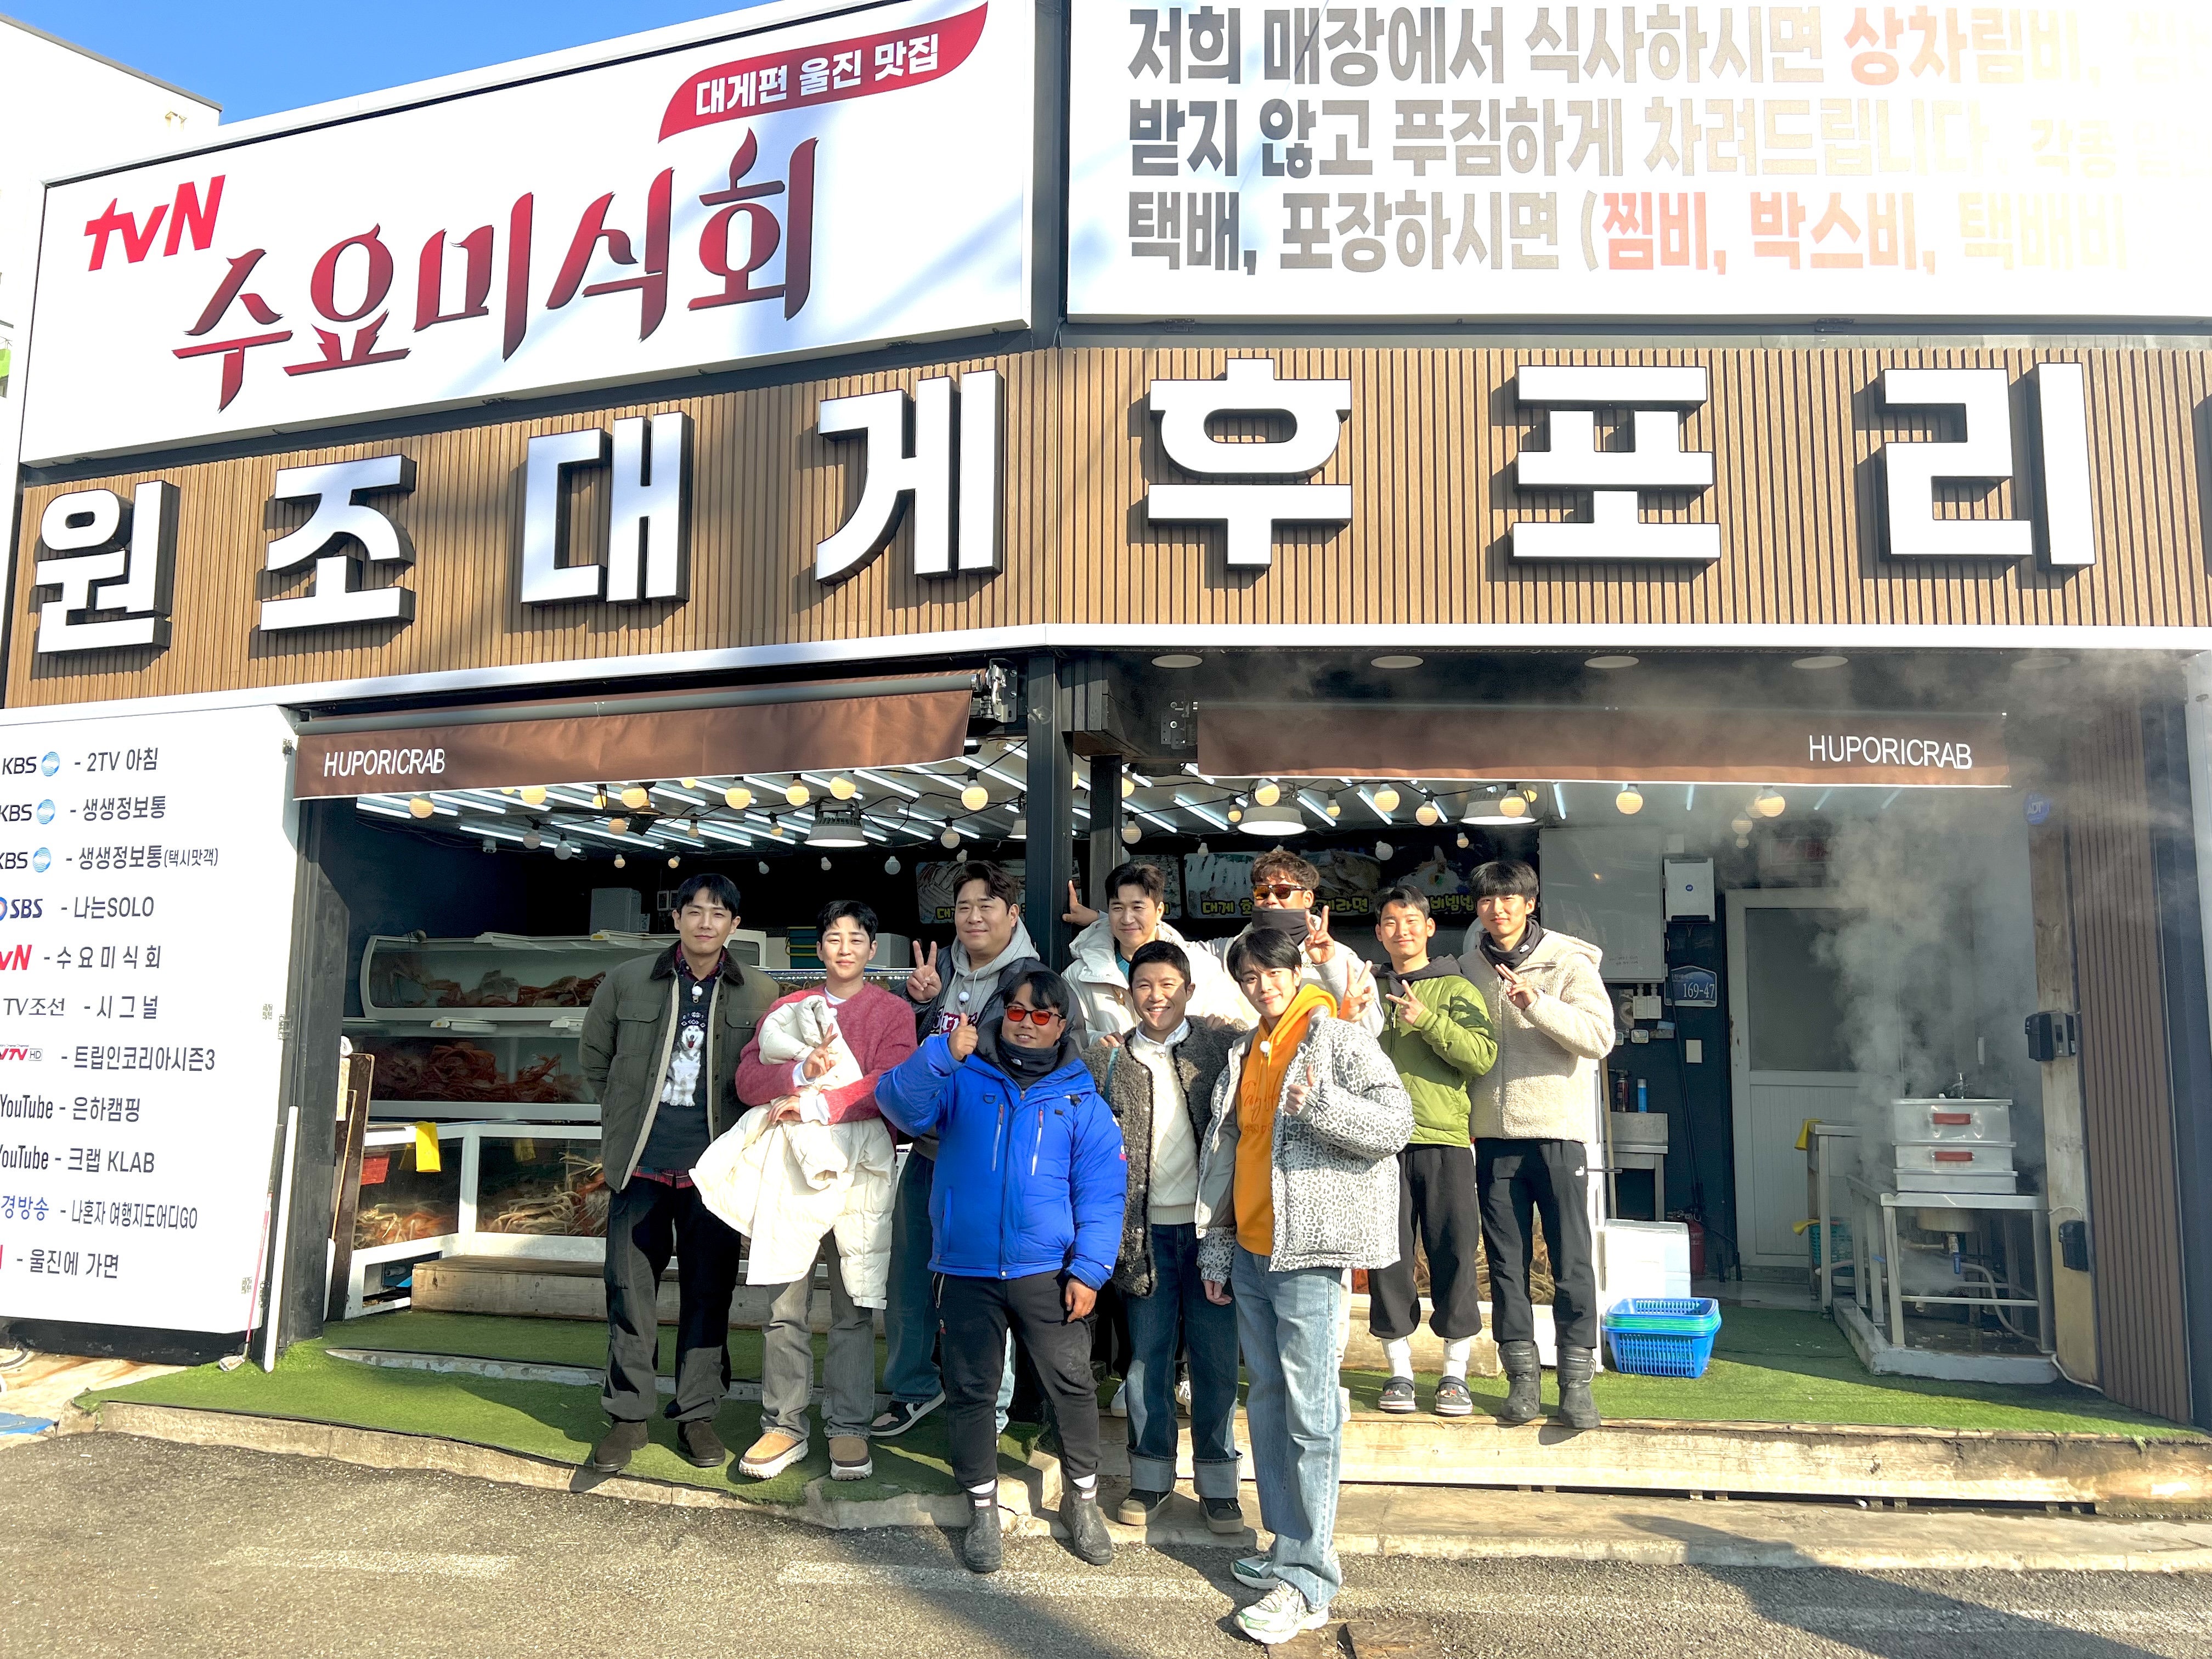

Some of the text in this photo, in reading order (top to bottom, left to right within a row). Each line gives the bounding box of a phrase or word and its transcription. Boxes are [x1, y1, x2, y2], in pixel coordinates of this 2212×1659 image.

[1127, 5, 1241, 85] 저희
[1264, 7, 1504, 87] 매장에서
[1525, 4, 1824, 84] 식사하시면
[1843, 5, 2101, 86] 상차림비,
[695, 34, 939, 117] 대게편 울진 맛집
[1130, 98, 1238, 177] 받지
[1259, 98, 1373, 179] 않고
[1393, 97, 1623, 177] 푸짐하게
[84, 174, 226, 272] tvN
[1128, 191, 1256, 275] 택배,
[1280, 190, 1559, 273] 포장하시면
[1751, 191, 1936, 275] 박스비,
[172, 127, 820, 414] 수요미식회
[2, 757, 37, 775] KBS
[87, 751, 121, 772] 2TV
[126, 747, 159, 771] 아침
[324, 748, 445, 777] HUPORICRAB
[1808, 735, 1973, 770] HUPORICRAB
[83, 795, 166, 821] 생생정보통
[9, 899, 43, 919] SBS
[74, 896, 154, 919] 나는SOLO
[1202, 901, 1234, 915] 대게
[1683, 981, 1715, 999] 169-47
[3, 997, 65, 1017] TV조선
[74, 1046, 216, 1071] 트립인코리아시즌3
[72, 1096, 140, 1122] 은하캠핑
[67, 1148, 101, 1173] 크랩
[107, 1150, 155, 1173] KLAB
[1, 1194, 49, 1221] 경방송
[71, 1199, 106, 1225] 나혼자
[109, 1201, 198, 1230] 여행지도어디GO
[30, 1249, 79, 1276] 울진에
[85, 1253, 119, 1279] 가면
